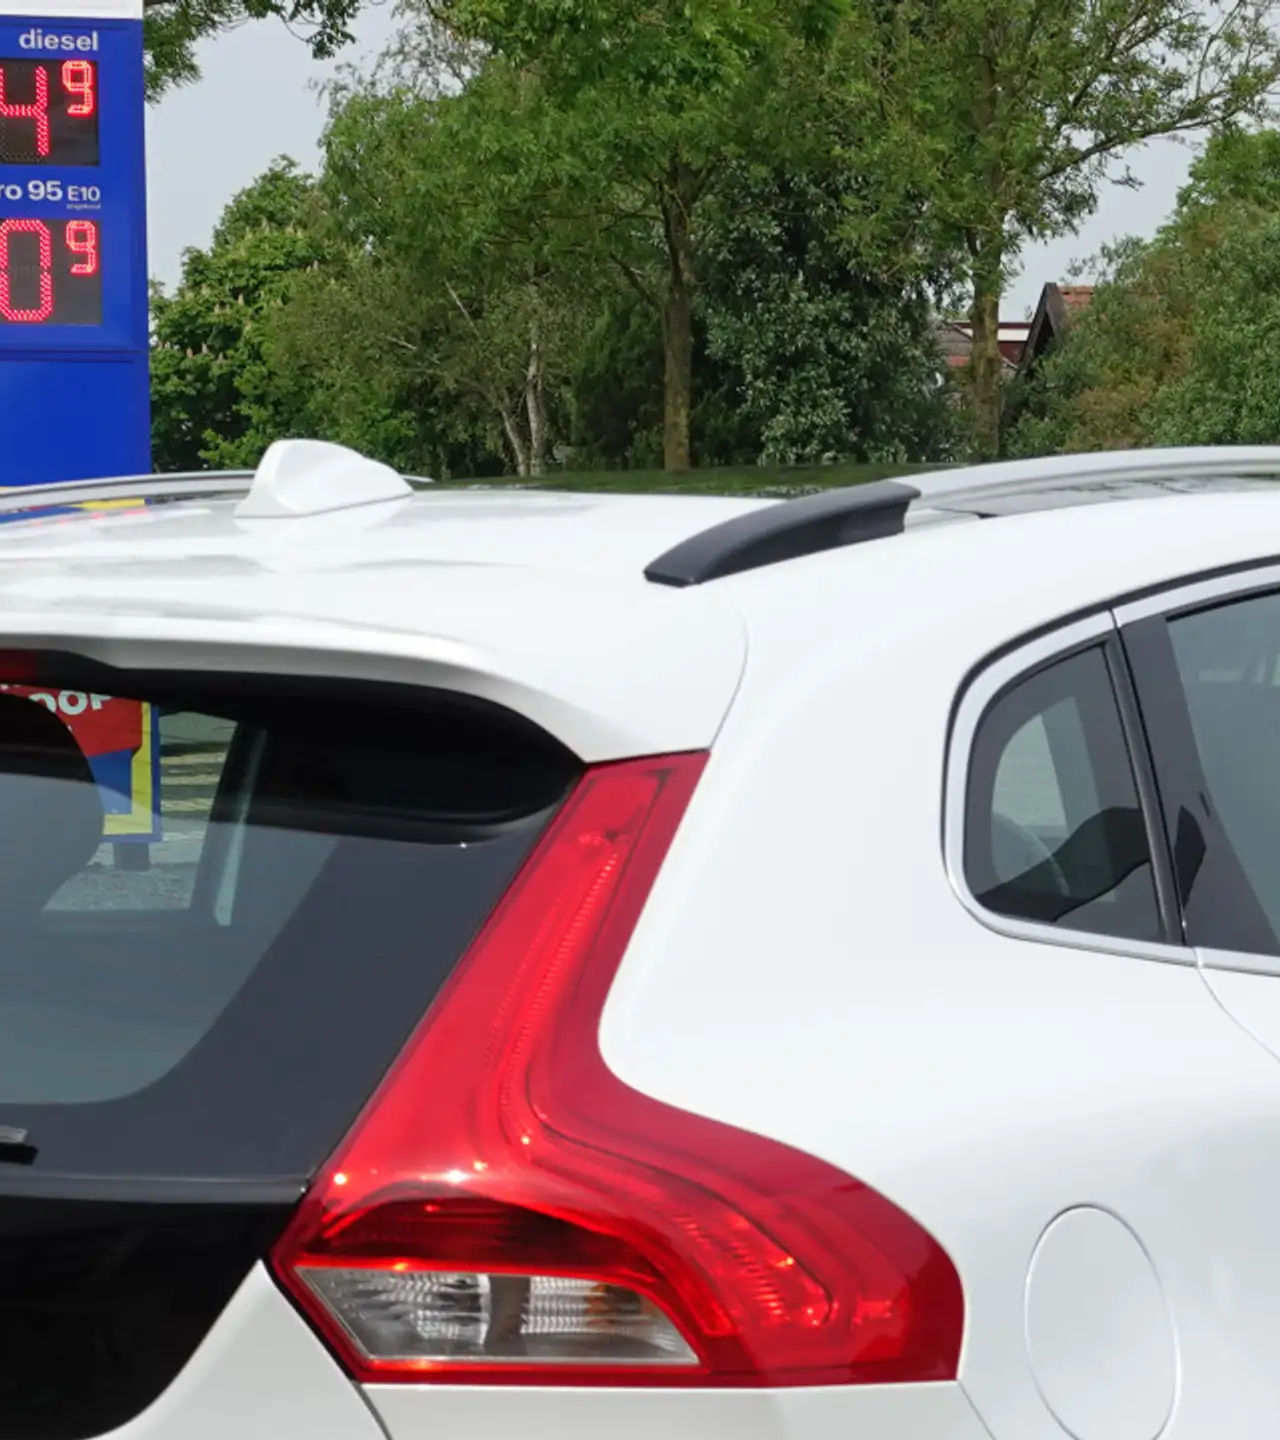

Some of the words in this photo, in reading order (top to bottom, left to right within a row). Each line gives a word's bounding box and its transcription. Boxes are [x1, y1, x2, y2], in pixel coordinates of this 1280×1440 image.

[19, 28, 99, 51] diesel
[28, 180, 63, 201] 95
[67, 186, 101, 201] E10
